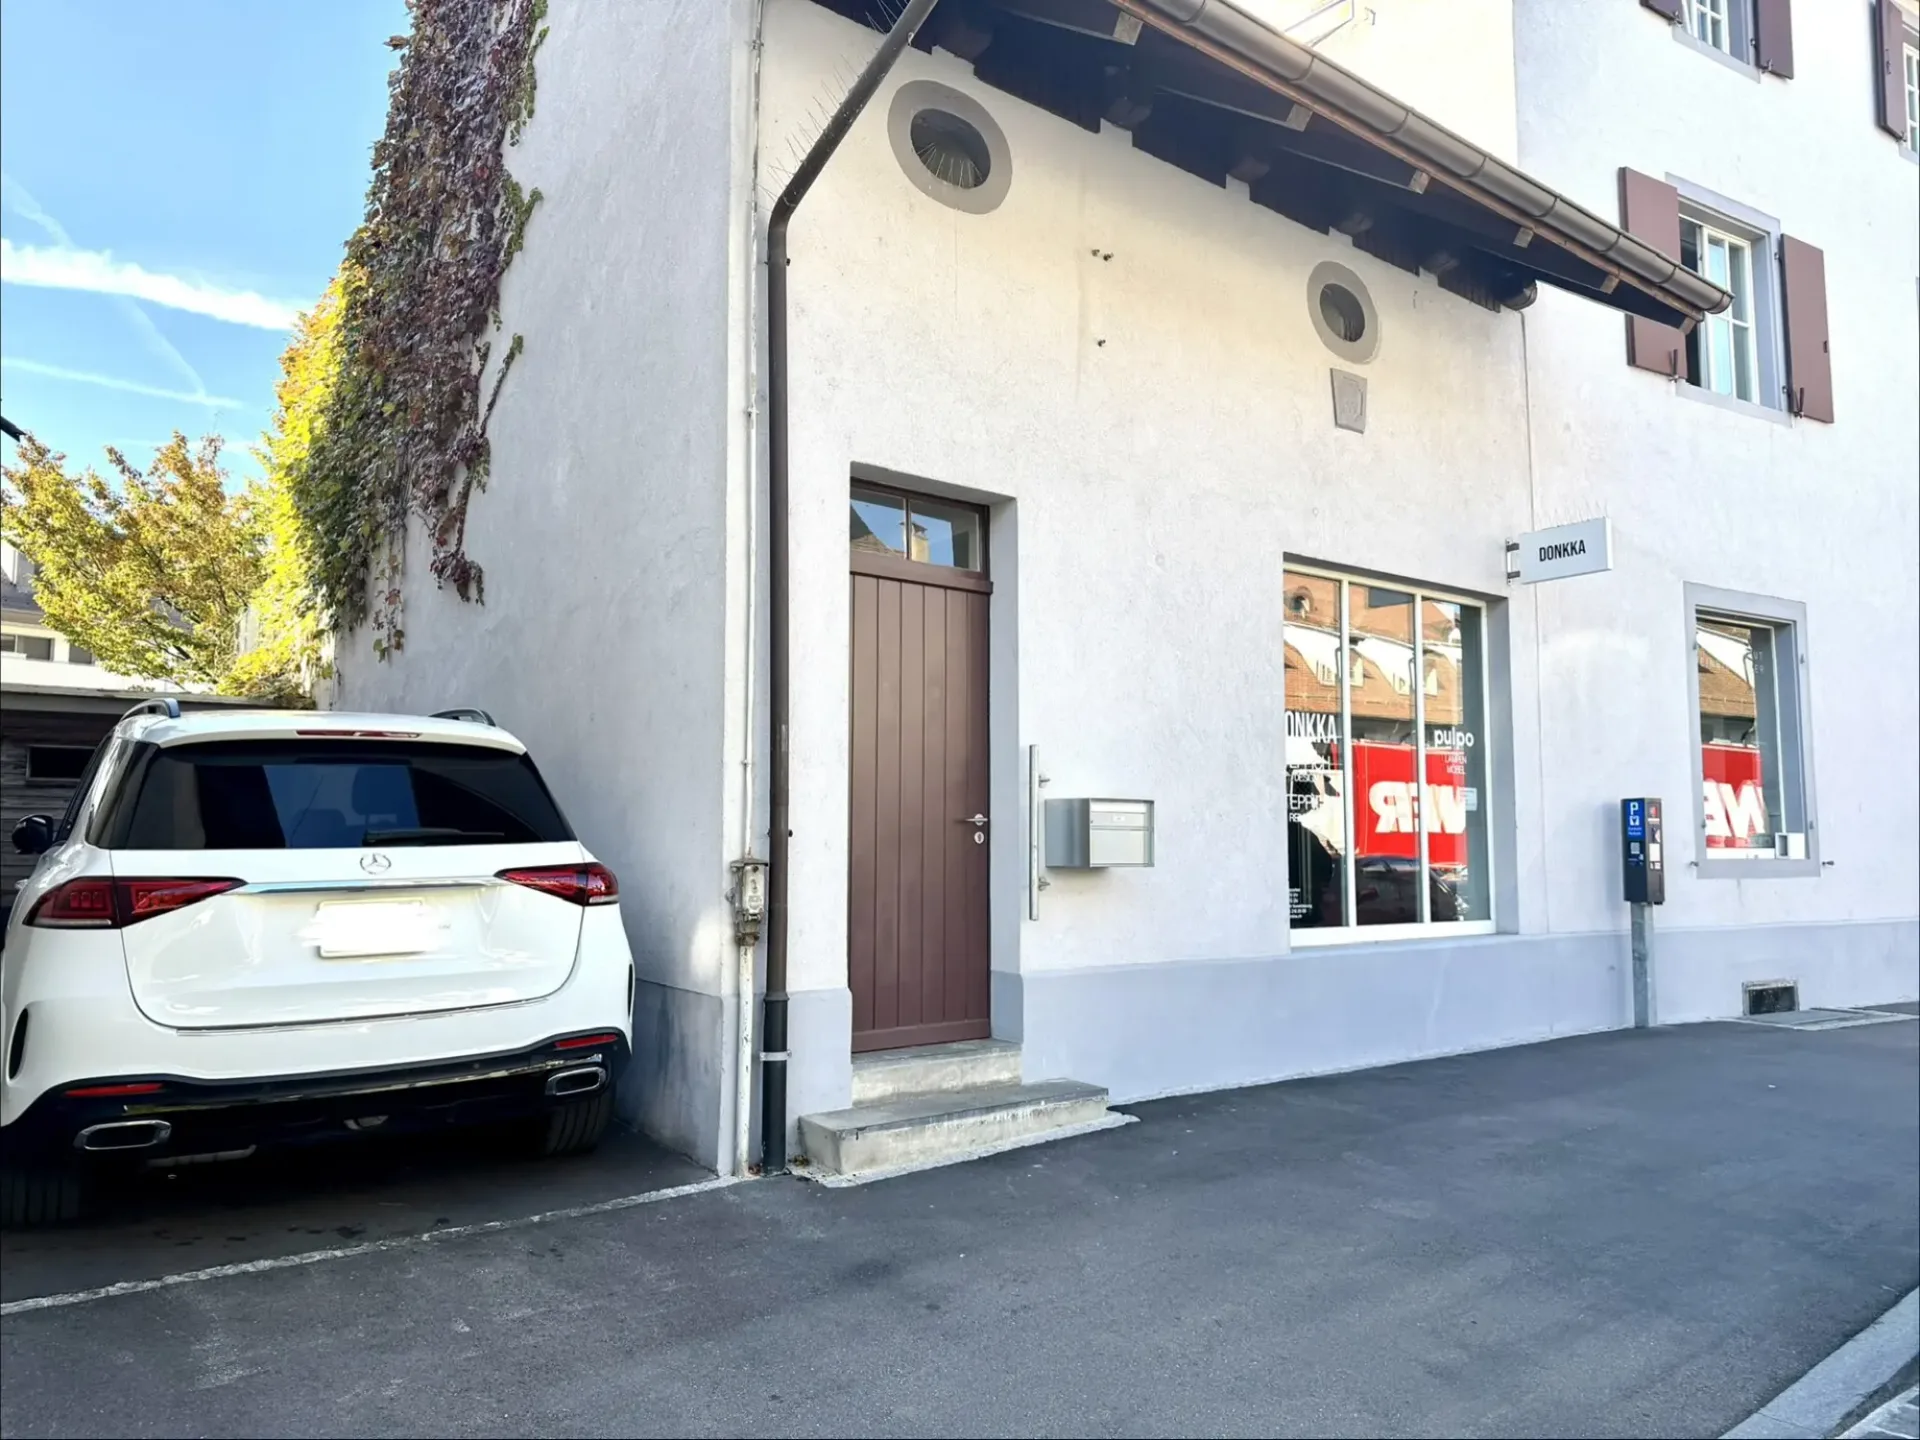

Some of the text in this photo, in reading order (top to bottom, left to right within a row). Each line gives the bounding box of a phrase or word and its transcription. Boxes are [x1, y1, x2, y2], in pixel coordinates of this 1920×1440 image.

[1539, 539, 1586, 562] DONKKA
[1434, 726, 1475, 749] pulpo
[1630, 801, 1639, 815] P
